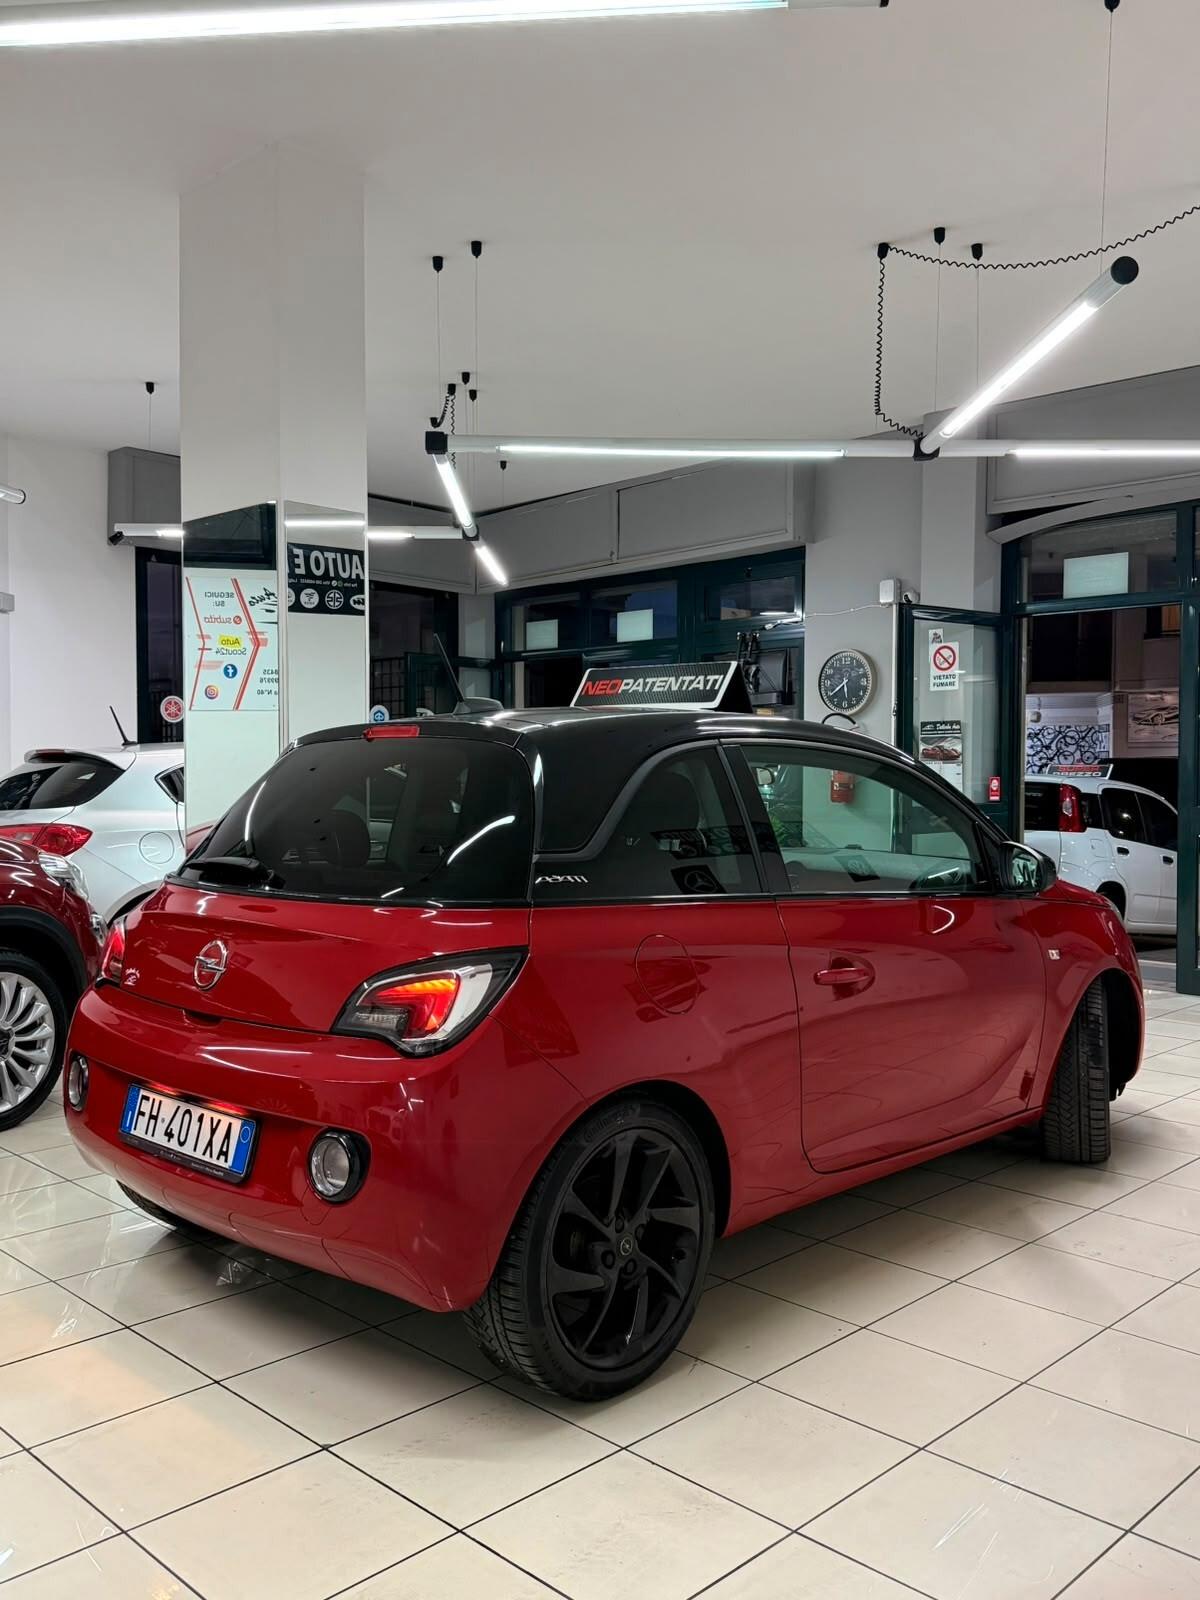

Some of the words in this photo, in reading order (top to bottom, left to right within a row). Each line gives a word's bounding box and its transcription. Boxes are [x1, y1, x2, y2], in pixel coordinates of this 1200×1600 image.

[581, 674, 724, 696] NEOPATENTATI
[933, 673, 956, 681] VIETATO
[133, 1094, 162, 1138] FH
[164, 1105, 233, 1163] 401XA
